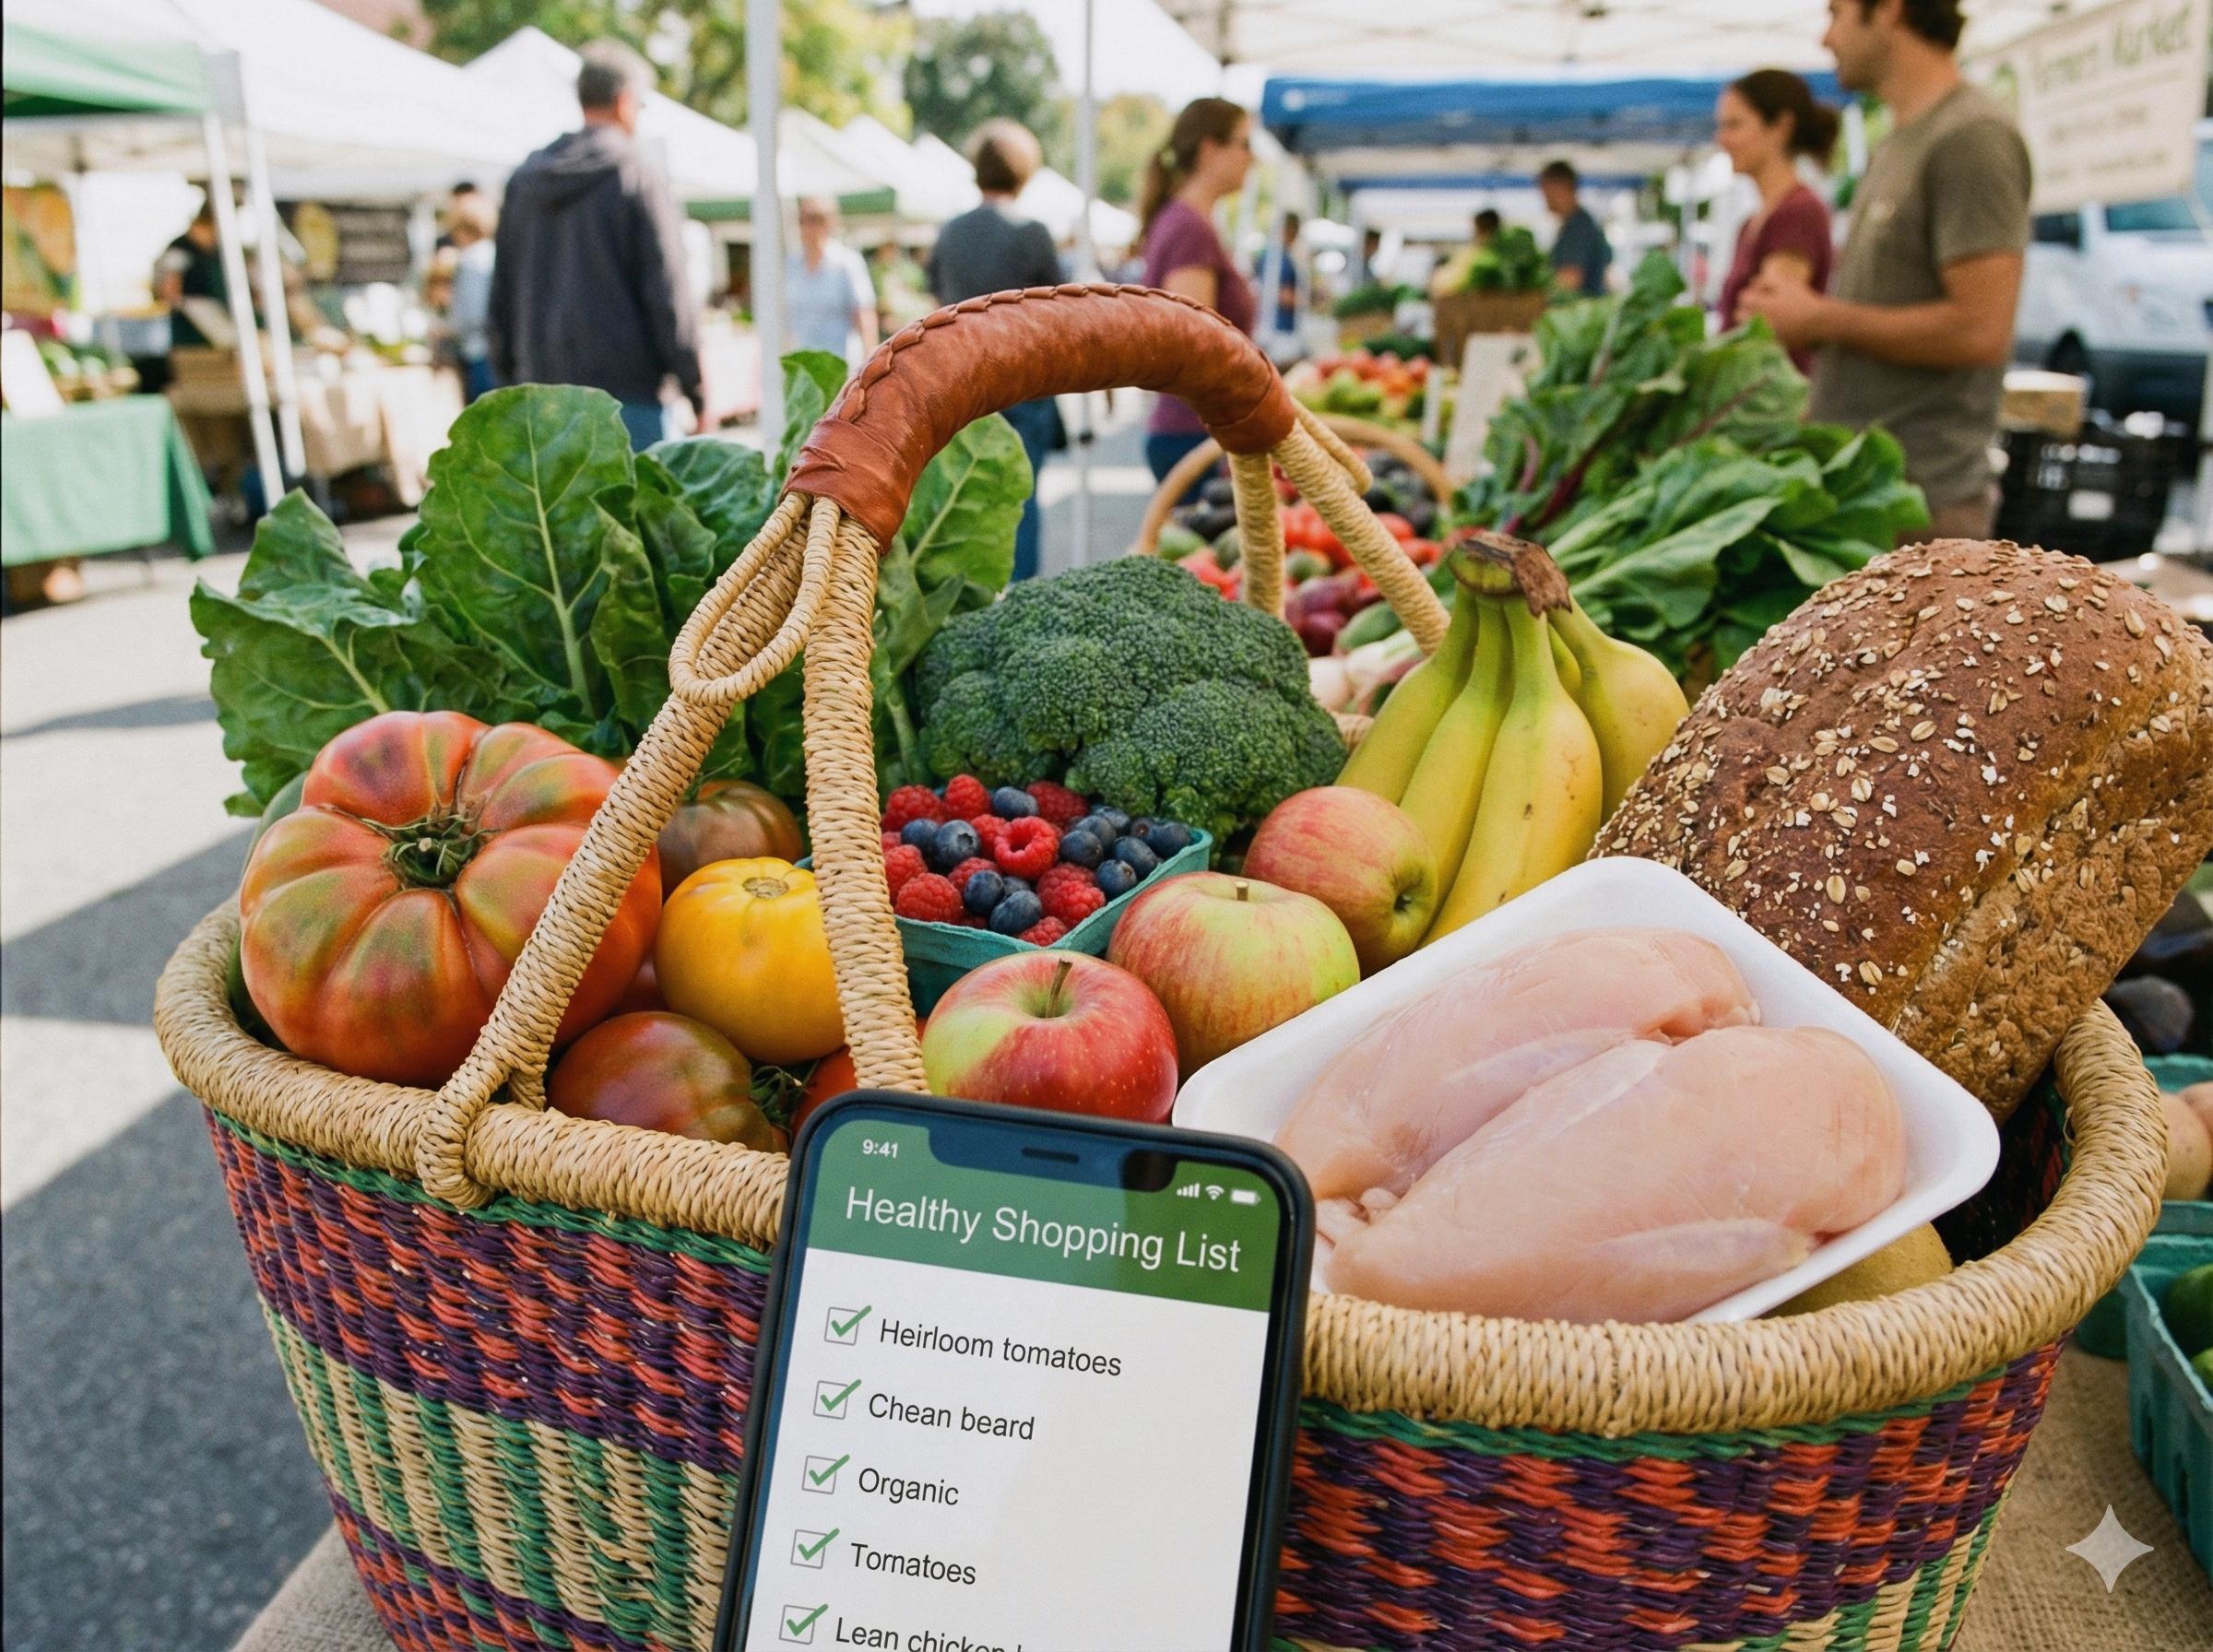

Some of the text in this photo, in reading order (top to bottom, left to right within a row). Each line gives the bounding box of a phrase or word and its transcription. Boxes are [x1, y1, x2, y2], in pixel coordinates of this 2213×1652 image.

[862, 1139, 899, 1159] 9:41
[846, 1186, 1241, 1273] Healthy Shopping List
[879, 1318, 1122, 1377] Heirloom tomatoes
[868, 1392, 1035, 1441] Chean beard
[858, 1467, 960, 1506] Organic
[834, 1616, 1006, 1652] Lean chick
